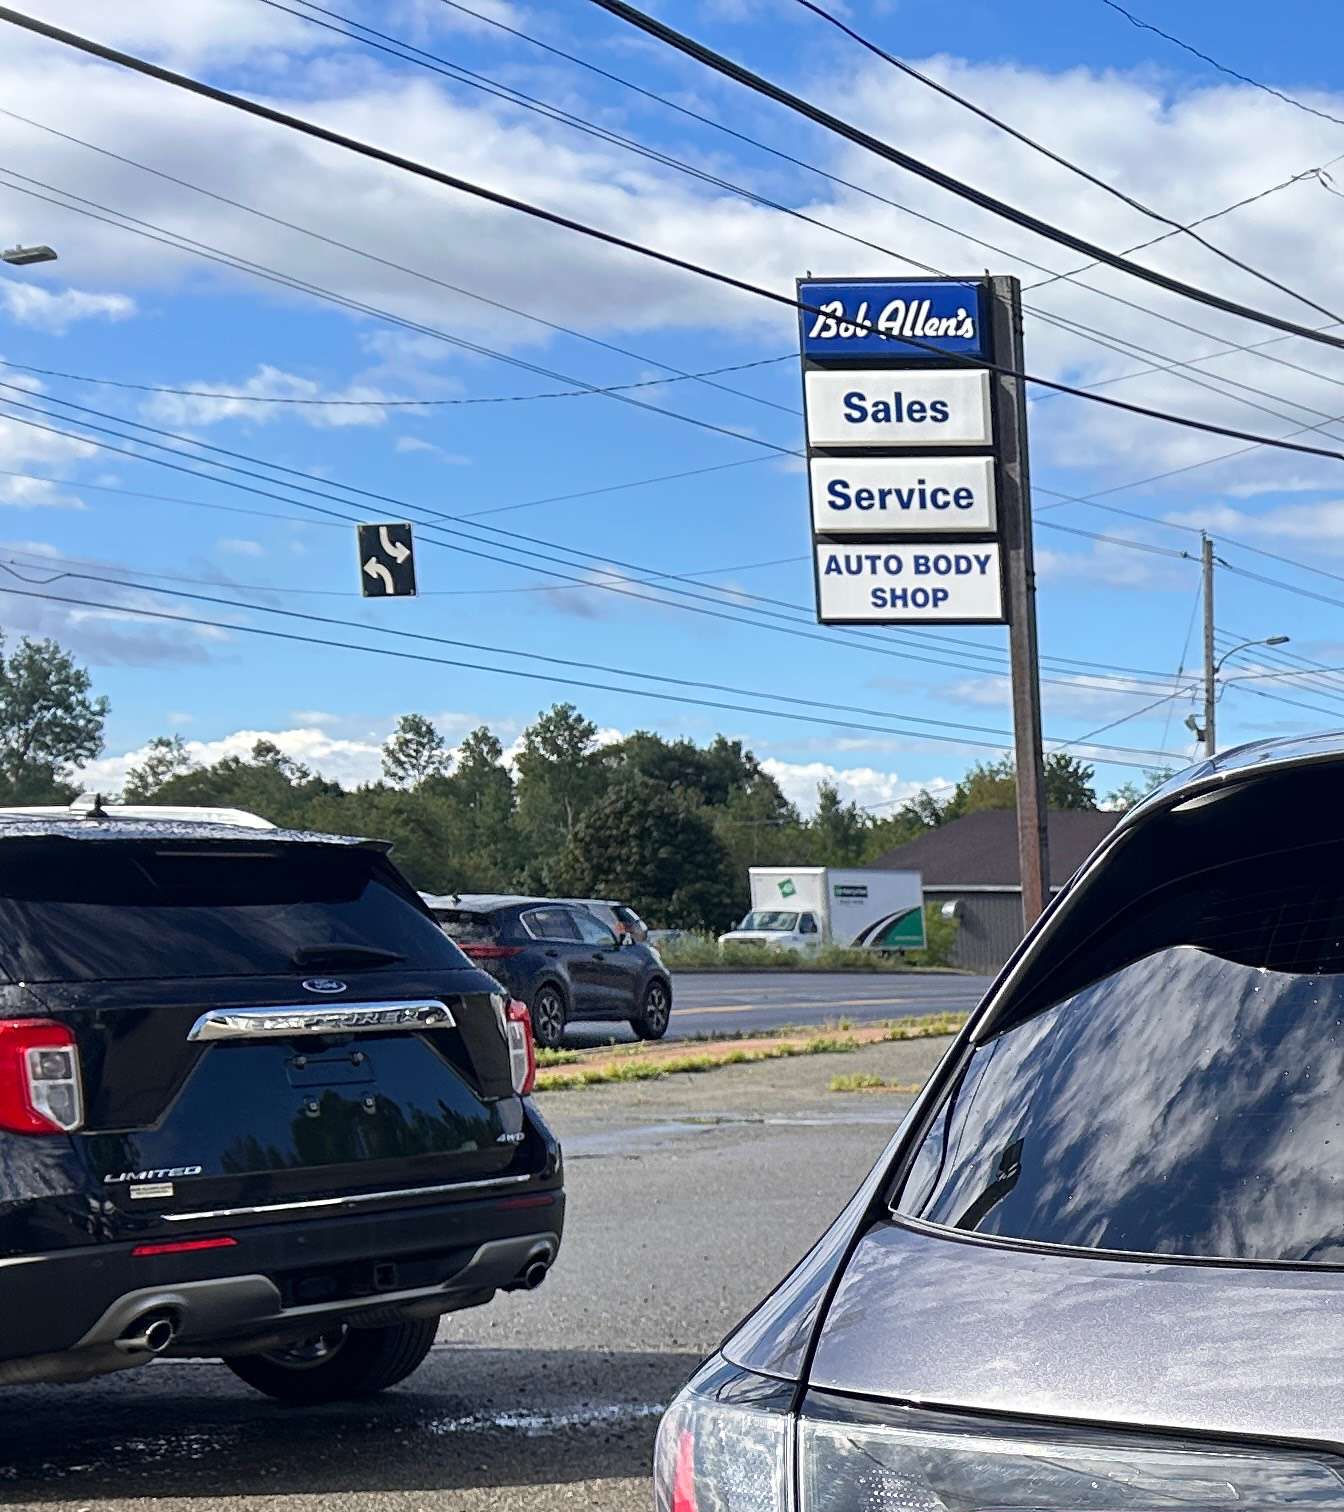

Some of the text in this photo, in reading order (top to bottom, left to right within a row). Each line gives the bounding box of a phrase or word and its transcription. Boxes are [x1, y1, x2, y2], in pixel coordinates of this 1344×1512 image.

[809, 299, 975, 339] Bob Allen's
[843, 391, 951, 424] Sales
[826, 478, 975, 512] Service
[824, 553, 993, 577] AUTO BODY
[870, 587, 950, 609] SHOP
[104, 1165, 202, 1183] LIMITED
